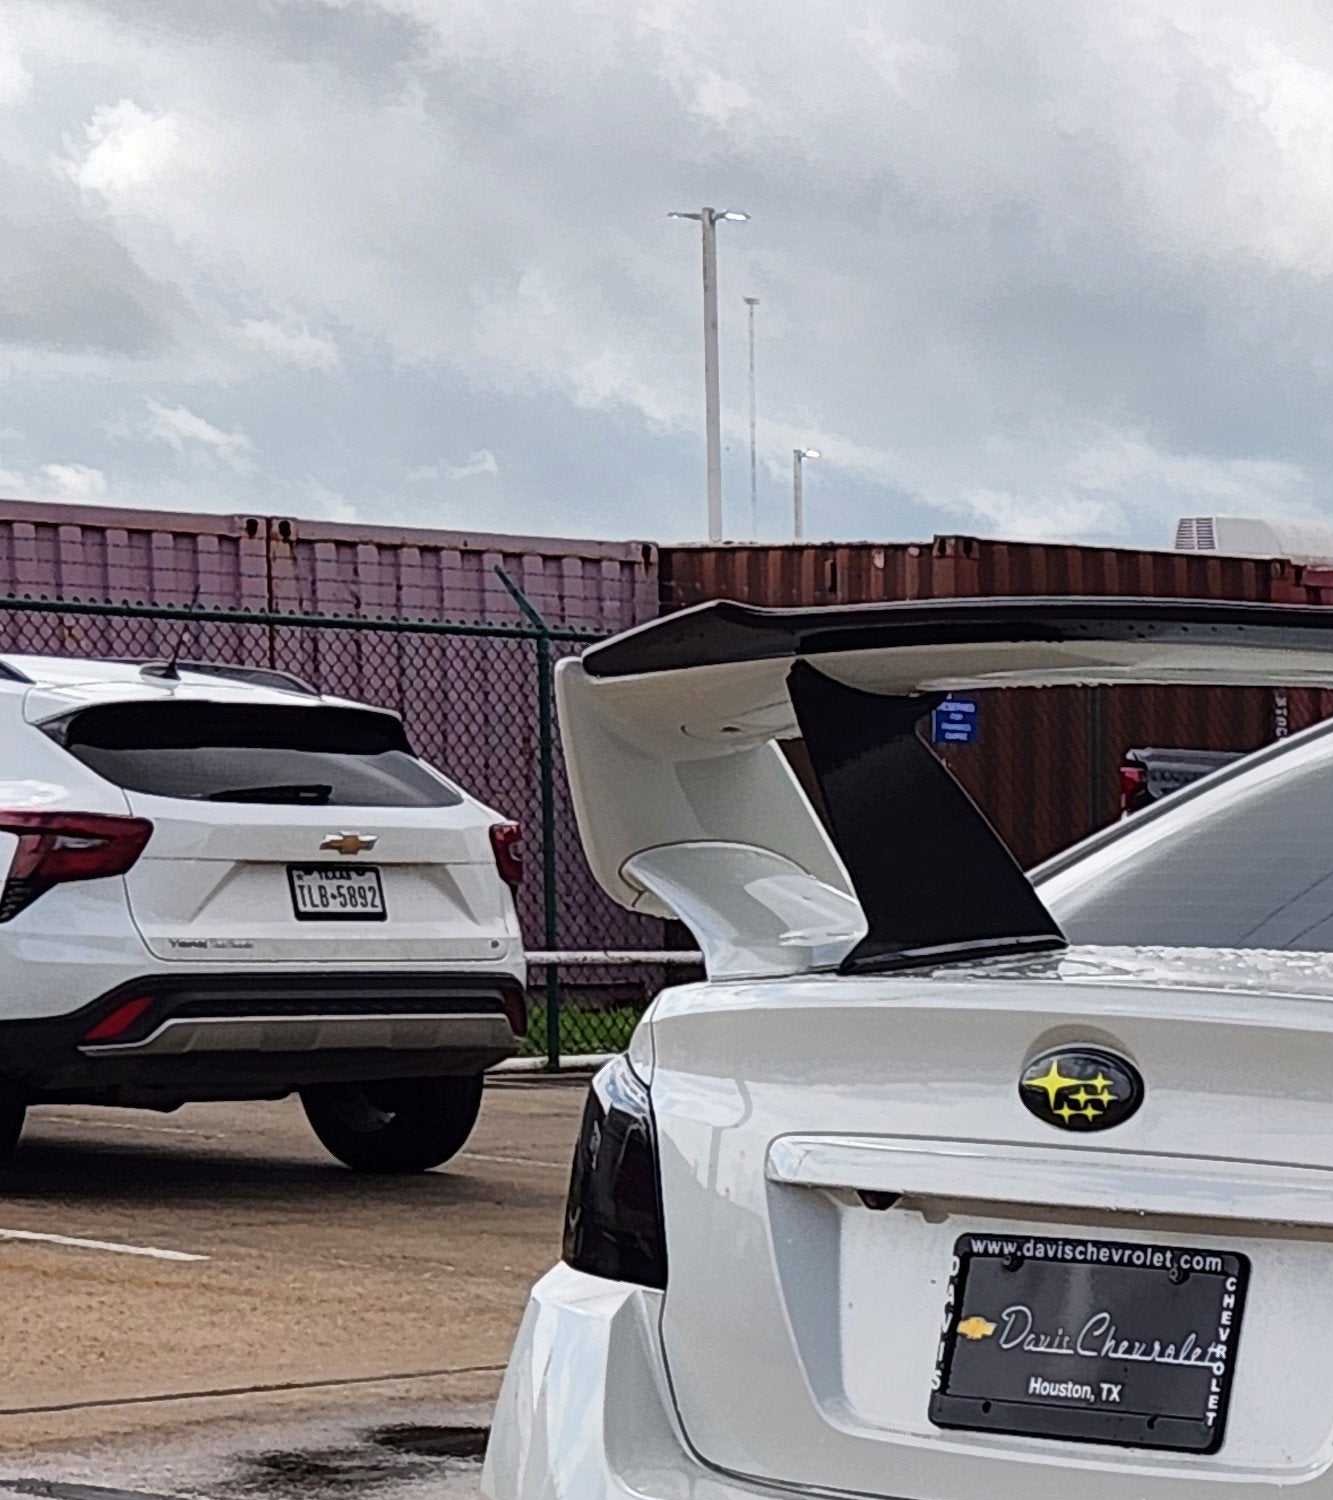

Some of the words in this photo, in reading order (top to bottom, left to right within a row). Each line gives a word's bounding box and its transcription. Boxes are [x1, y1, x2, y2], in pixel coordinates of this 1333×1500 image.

[970, 1239, 1222, 1272] www.davischevrolet.com
[1000, 1306, 1074, 1354] Davis
[1076, 1312, 1217, 1366] Chevrolet
[1206, 1277, 1237, 1426] CHEVROLET
[1028, 1377, 1095, 1402] Houston,
[1100, 1383, 1121, 1402] TX
